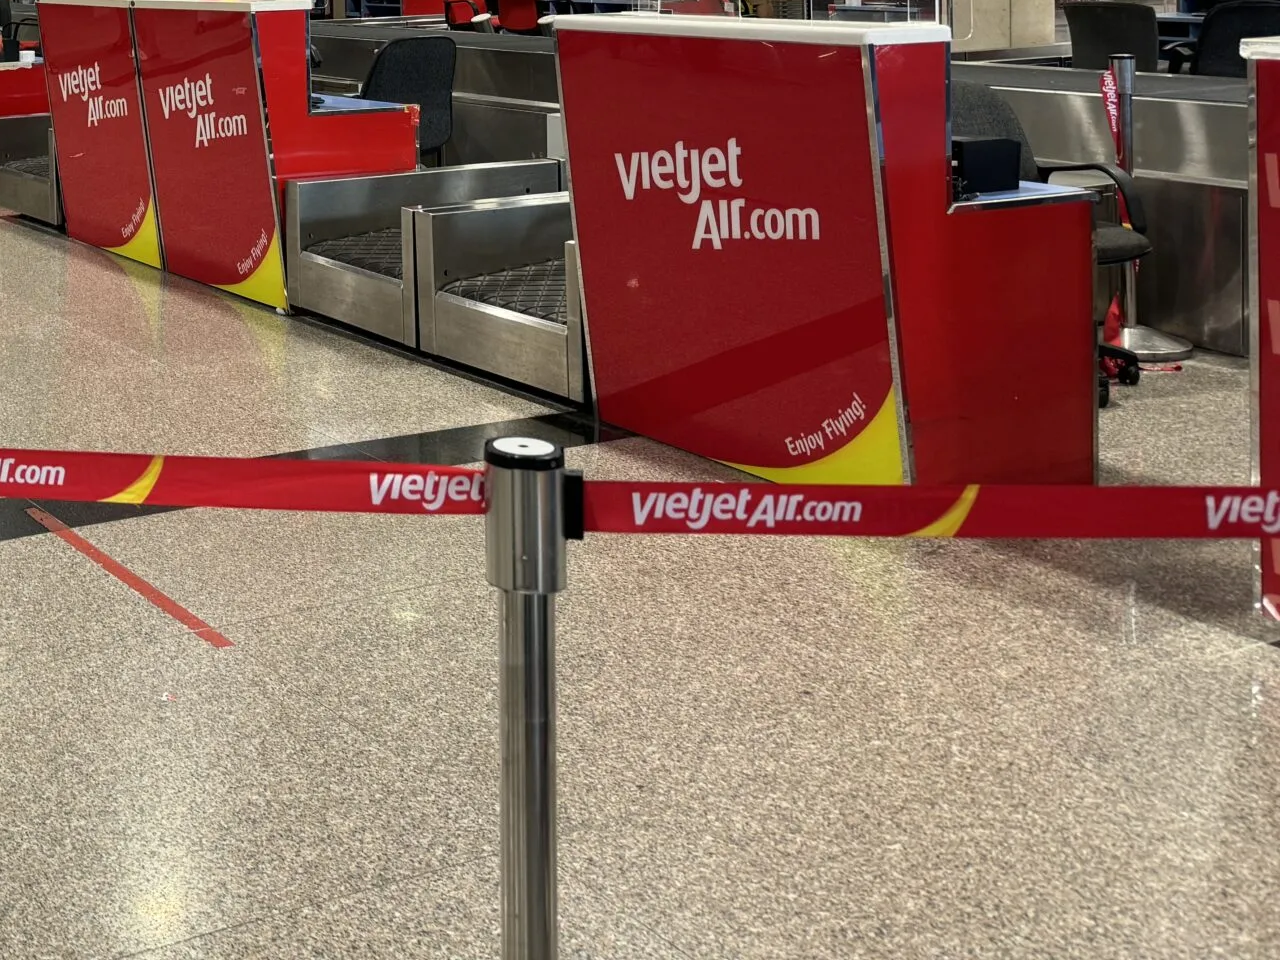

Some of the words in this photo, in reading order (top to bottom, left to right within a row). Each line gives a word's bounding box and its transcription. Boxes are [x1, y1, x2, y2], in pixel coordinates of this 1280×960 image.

[236, 250, 254, 275] Enjoy
[250, 228, 269, 261] Flying!
[784, 426, 824, 457] Enjoy
[822, 392, 867, 442] Flying!
[368, 470, 486, 510] vietjet
